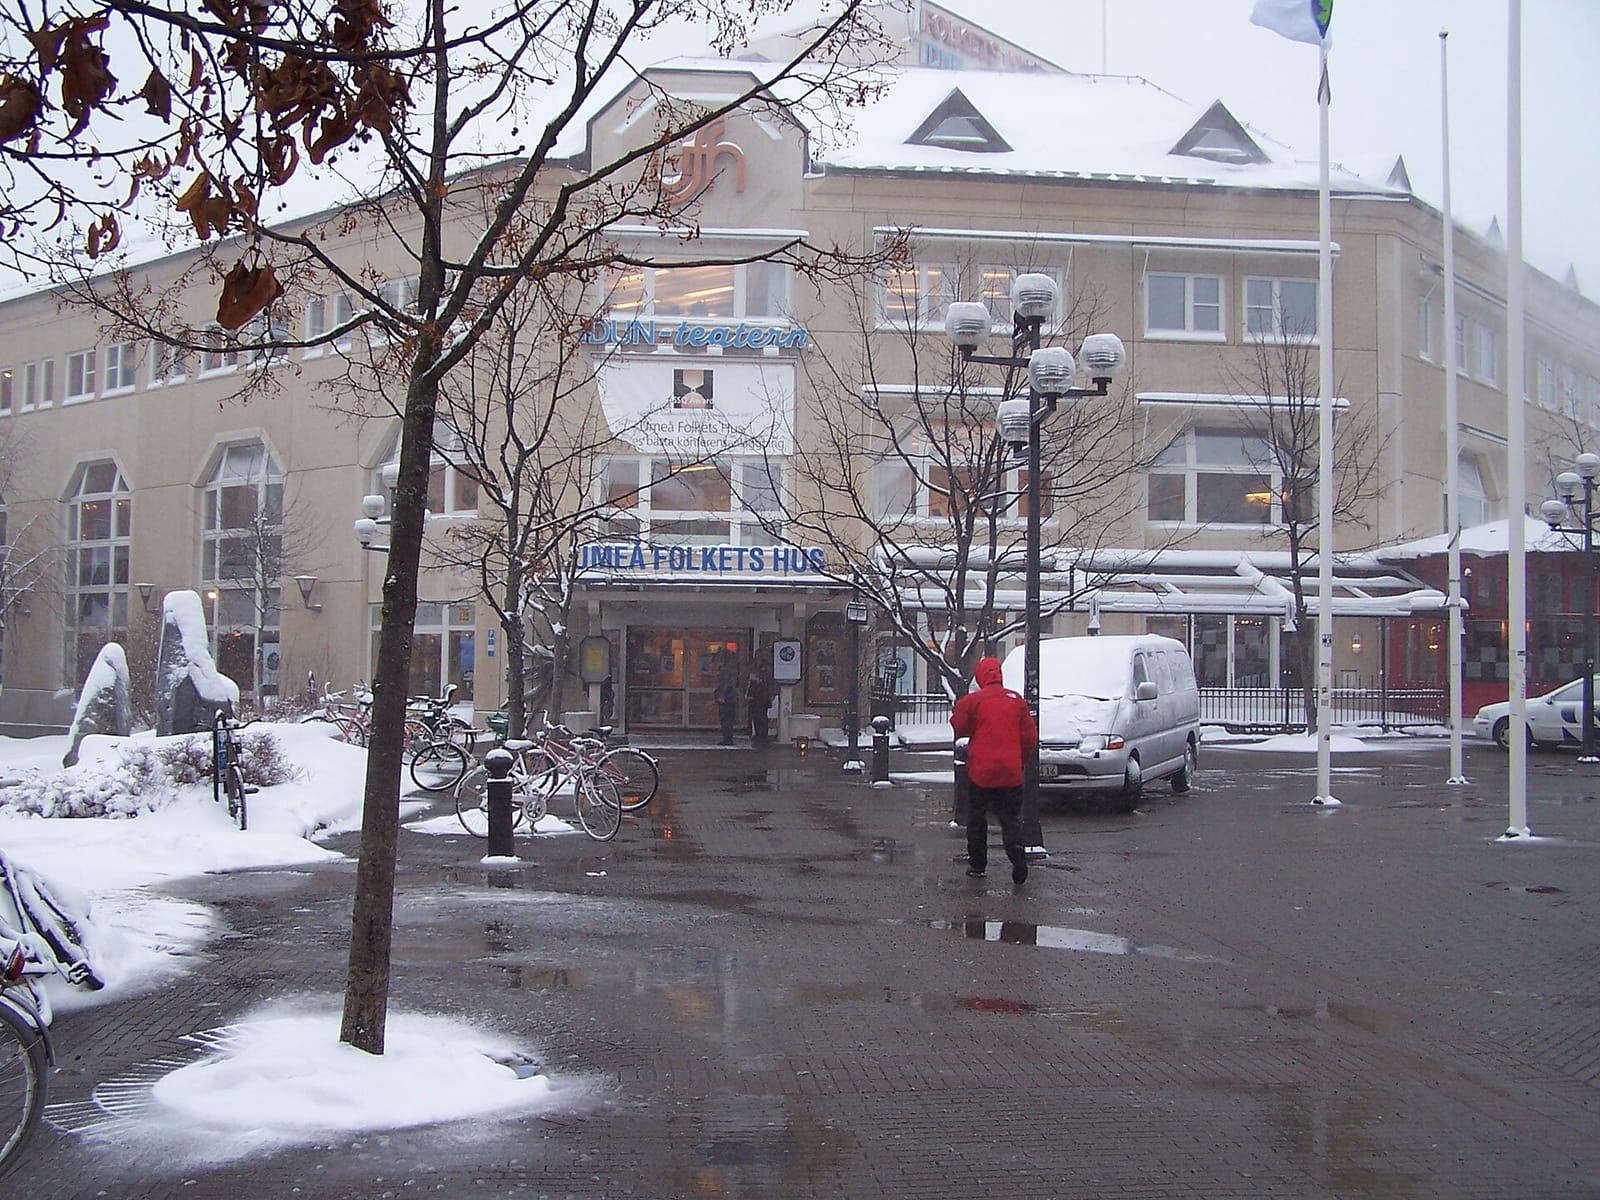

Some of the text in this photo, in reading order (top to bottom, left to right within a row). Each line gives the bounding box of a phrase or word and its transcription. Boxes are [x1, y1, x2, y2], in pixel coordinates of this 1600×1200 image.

[581, 319, 807, 349] DUN-teatern
[678, 421, 718, 434] Folkets
[722, 423, 745, 436] Hus
[653, 546, 765, 573] FOLKETS
[773, 547, 825, 573] HUS
